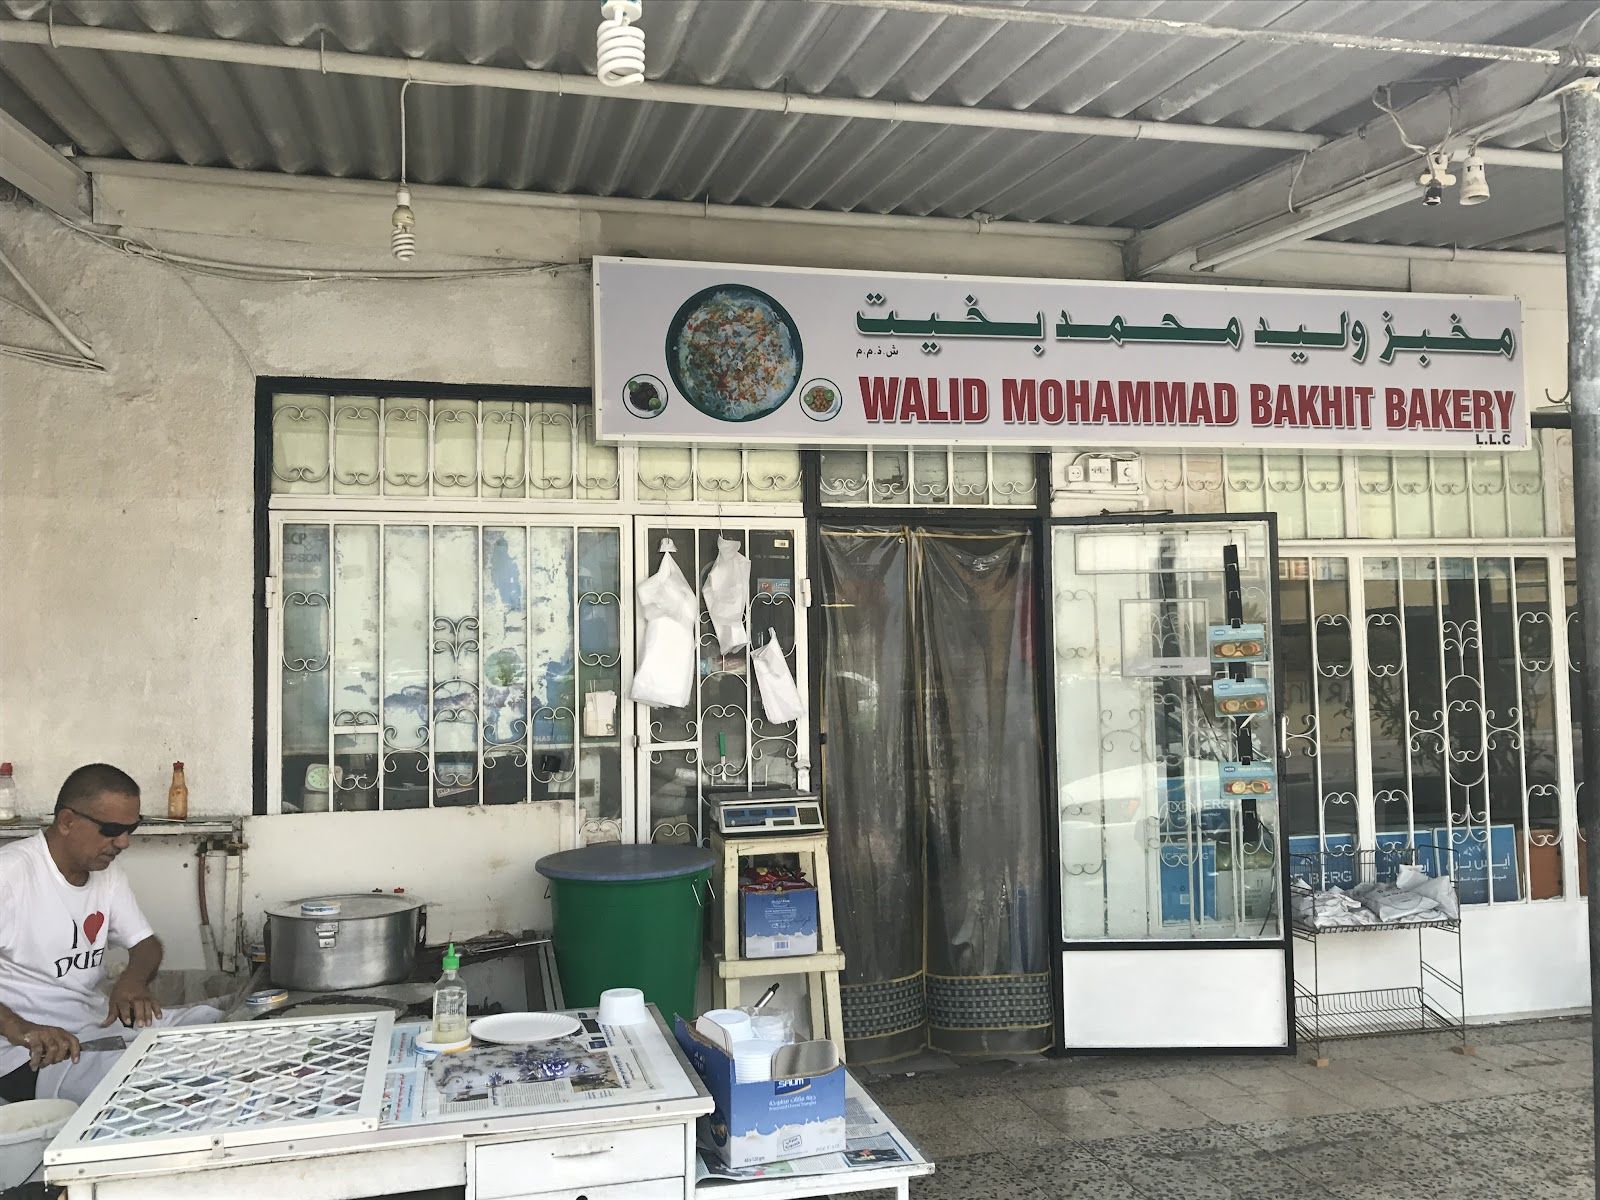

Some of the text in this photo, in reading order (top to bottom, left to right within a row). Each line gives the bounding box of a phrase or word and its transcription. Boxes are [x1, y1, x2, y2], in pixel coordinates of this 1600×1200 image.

[855, 291, 1515, 366] مخبز وليد محمد بخيت
[858, 376, 1514, 431] WALID MOHAMMAD BAKHIT BAKERY
[283, 553, 321, 562] EPSON
[71, 919, 78, 950] I
